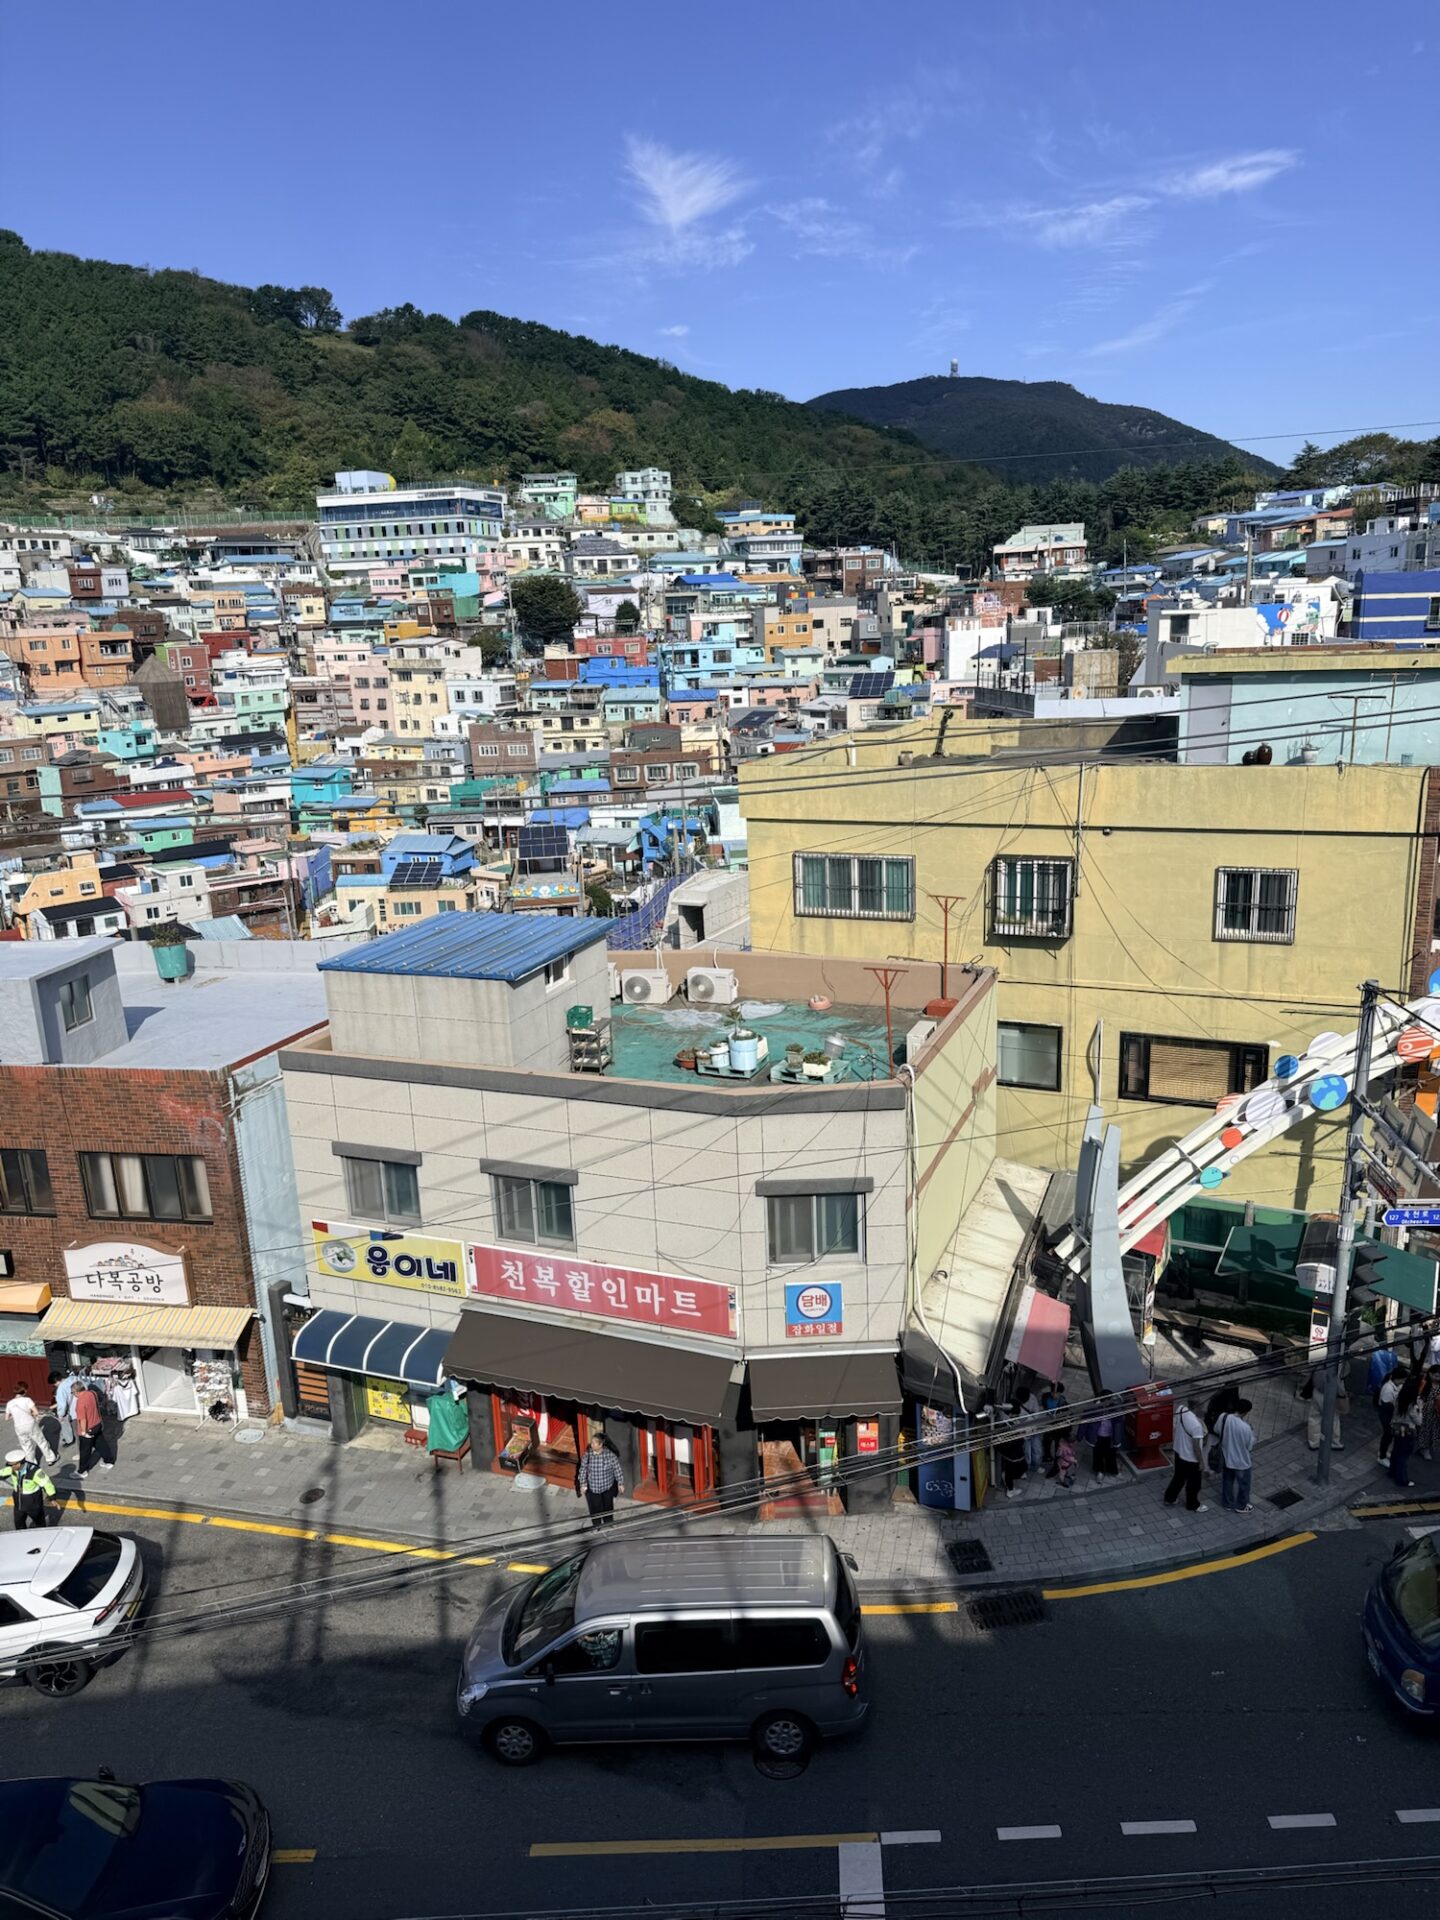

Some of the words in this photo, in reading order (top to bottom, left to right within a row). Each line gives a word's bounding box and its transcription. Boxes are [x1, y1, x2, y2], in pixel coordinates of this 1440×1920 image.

[366, 1245, 457, 1282] 웅이네
[86, 1271, 164, 1293] 다복공방
[500, 1260, 702, 1316] 천복할인마트
[801, 1295, 828, 1307] 담배
